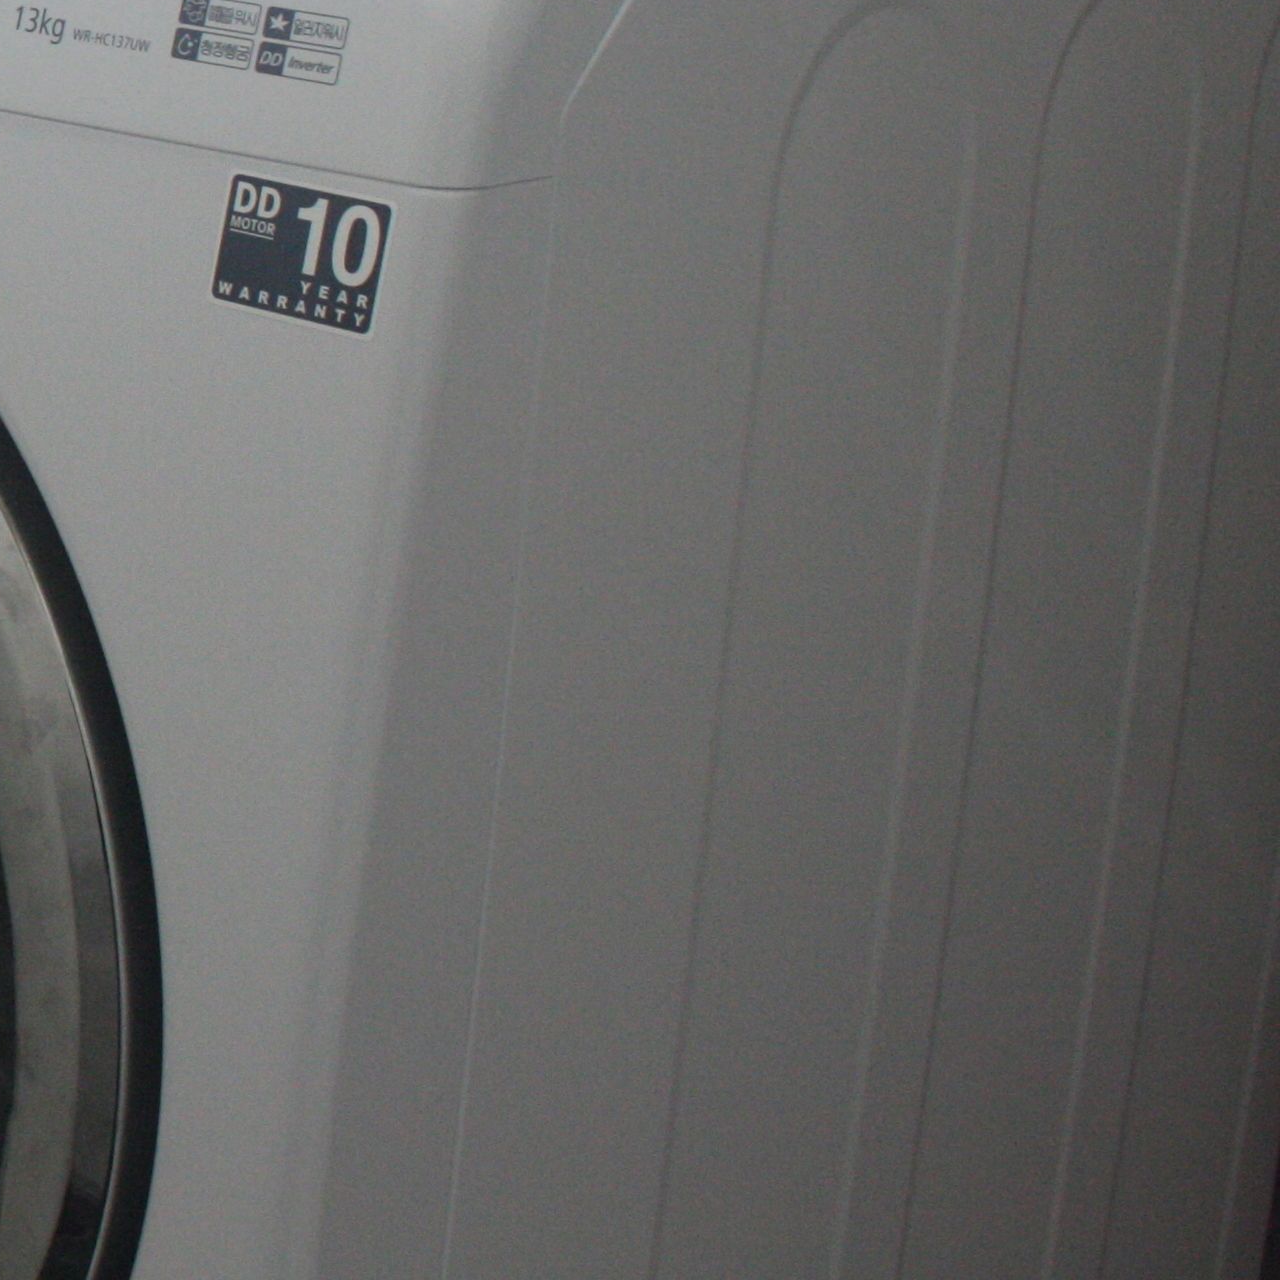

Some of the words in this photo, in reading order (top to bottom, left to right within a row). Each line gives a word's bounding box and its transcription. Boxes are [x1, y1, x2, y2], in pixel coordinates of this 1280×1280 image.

[16, 6, 66, 45] 13kg
[260, 51, 283, 67] DD
[288, 56, 335, 75] Inverter
[233, 180, 282, 219] DD
[230, 215, 277, 236] MOTOR
[297, 197, 381, 288] 10
[218, 281, 366, 328] WARRANTY
[300, 281, 369, 309] YEAR
